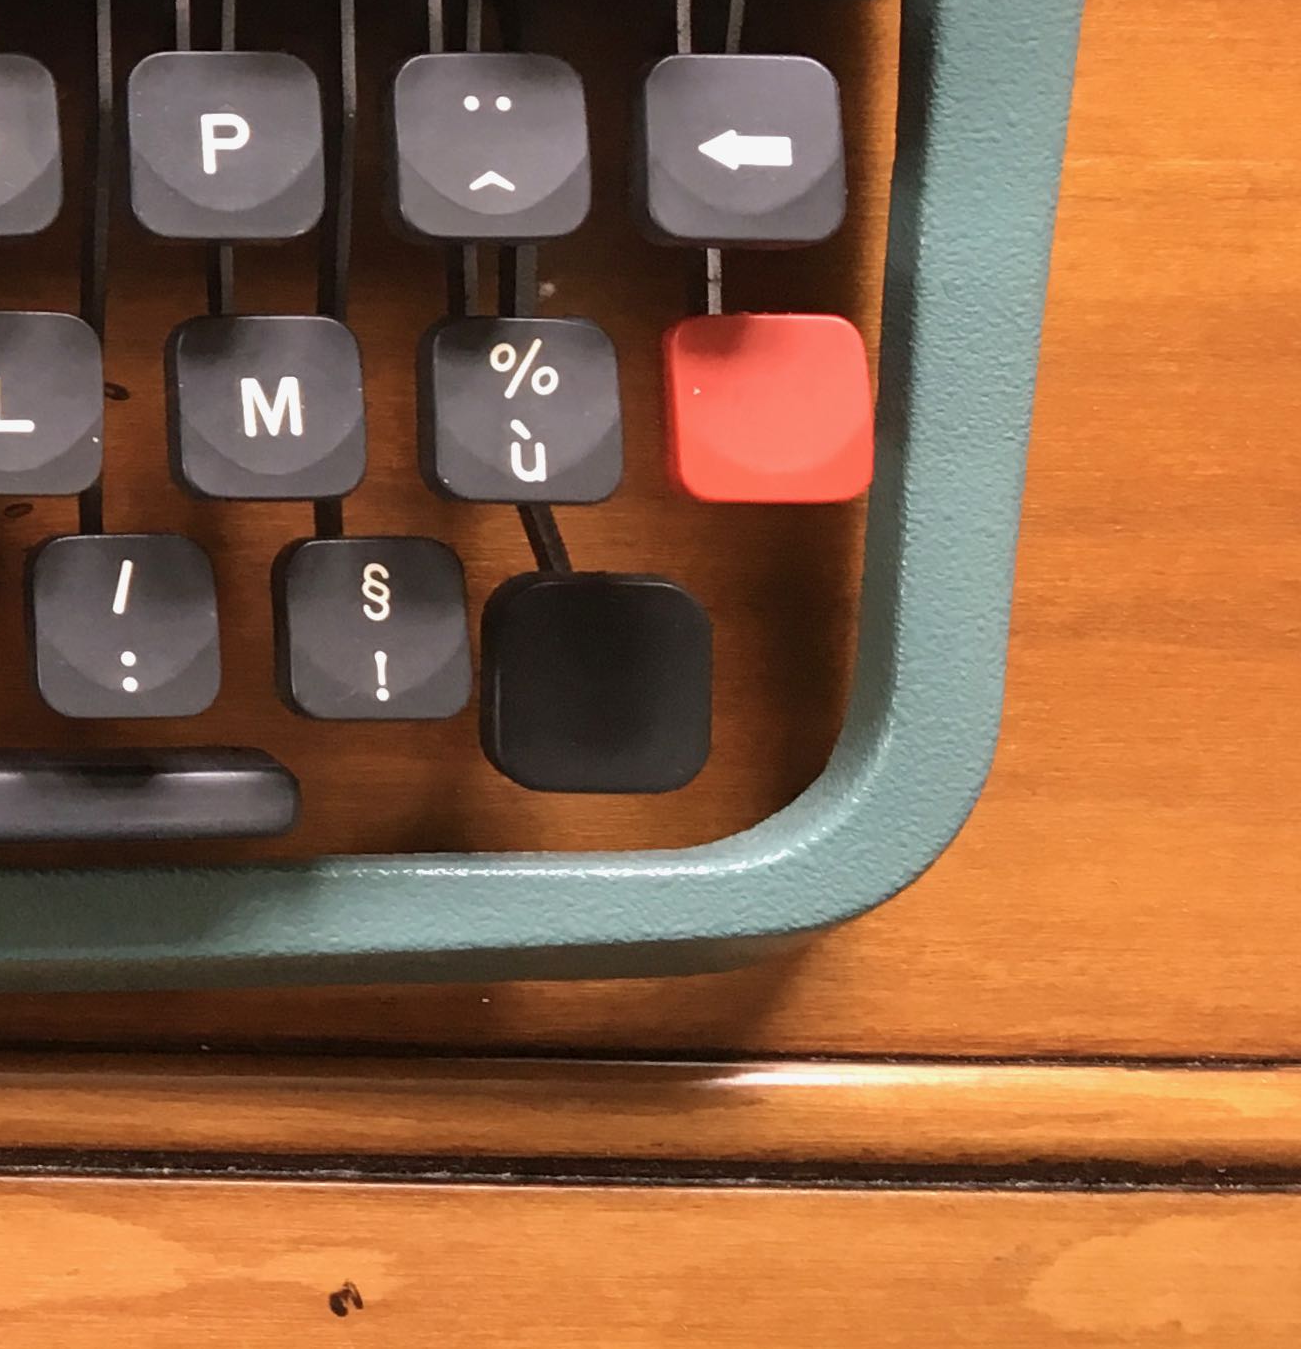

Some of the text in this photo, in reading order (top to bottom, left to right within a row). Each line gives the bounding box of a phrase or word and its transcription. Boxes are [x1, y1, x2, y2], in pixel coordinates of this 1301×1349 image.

[200, 113, 250, 175] P
[490, 338, 559, 399] %
[240, 376, 303, 438] M
[510, 419, 547, 482] ù
[112, 559, 133, 615] /
[361, 563, 390, 622] §
[120, 650, 139, 693] :
[374, 650, 390, 702] !
